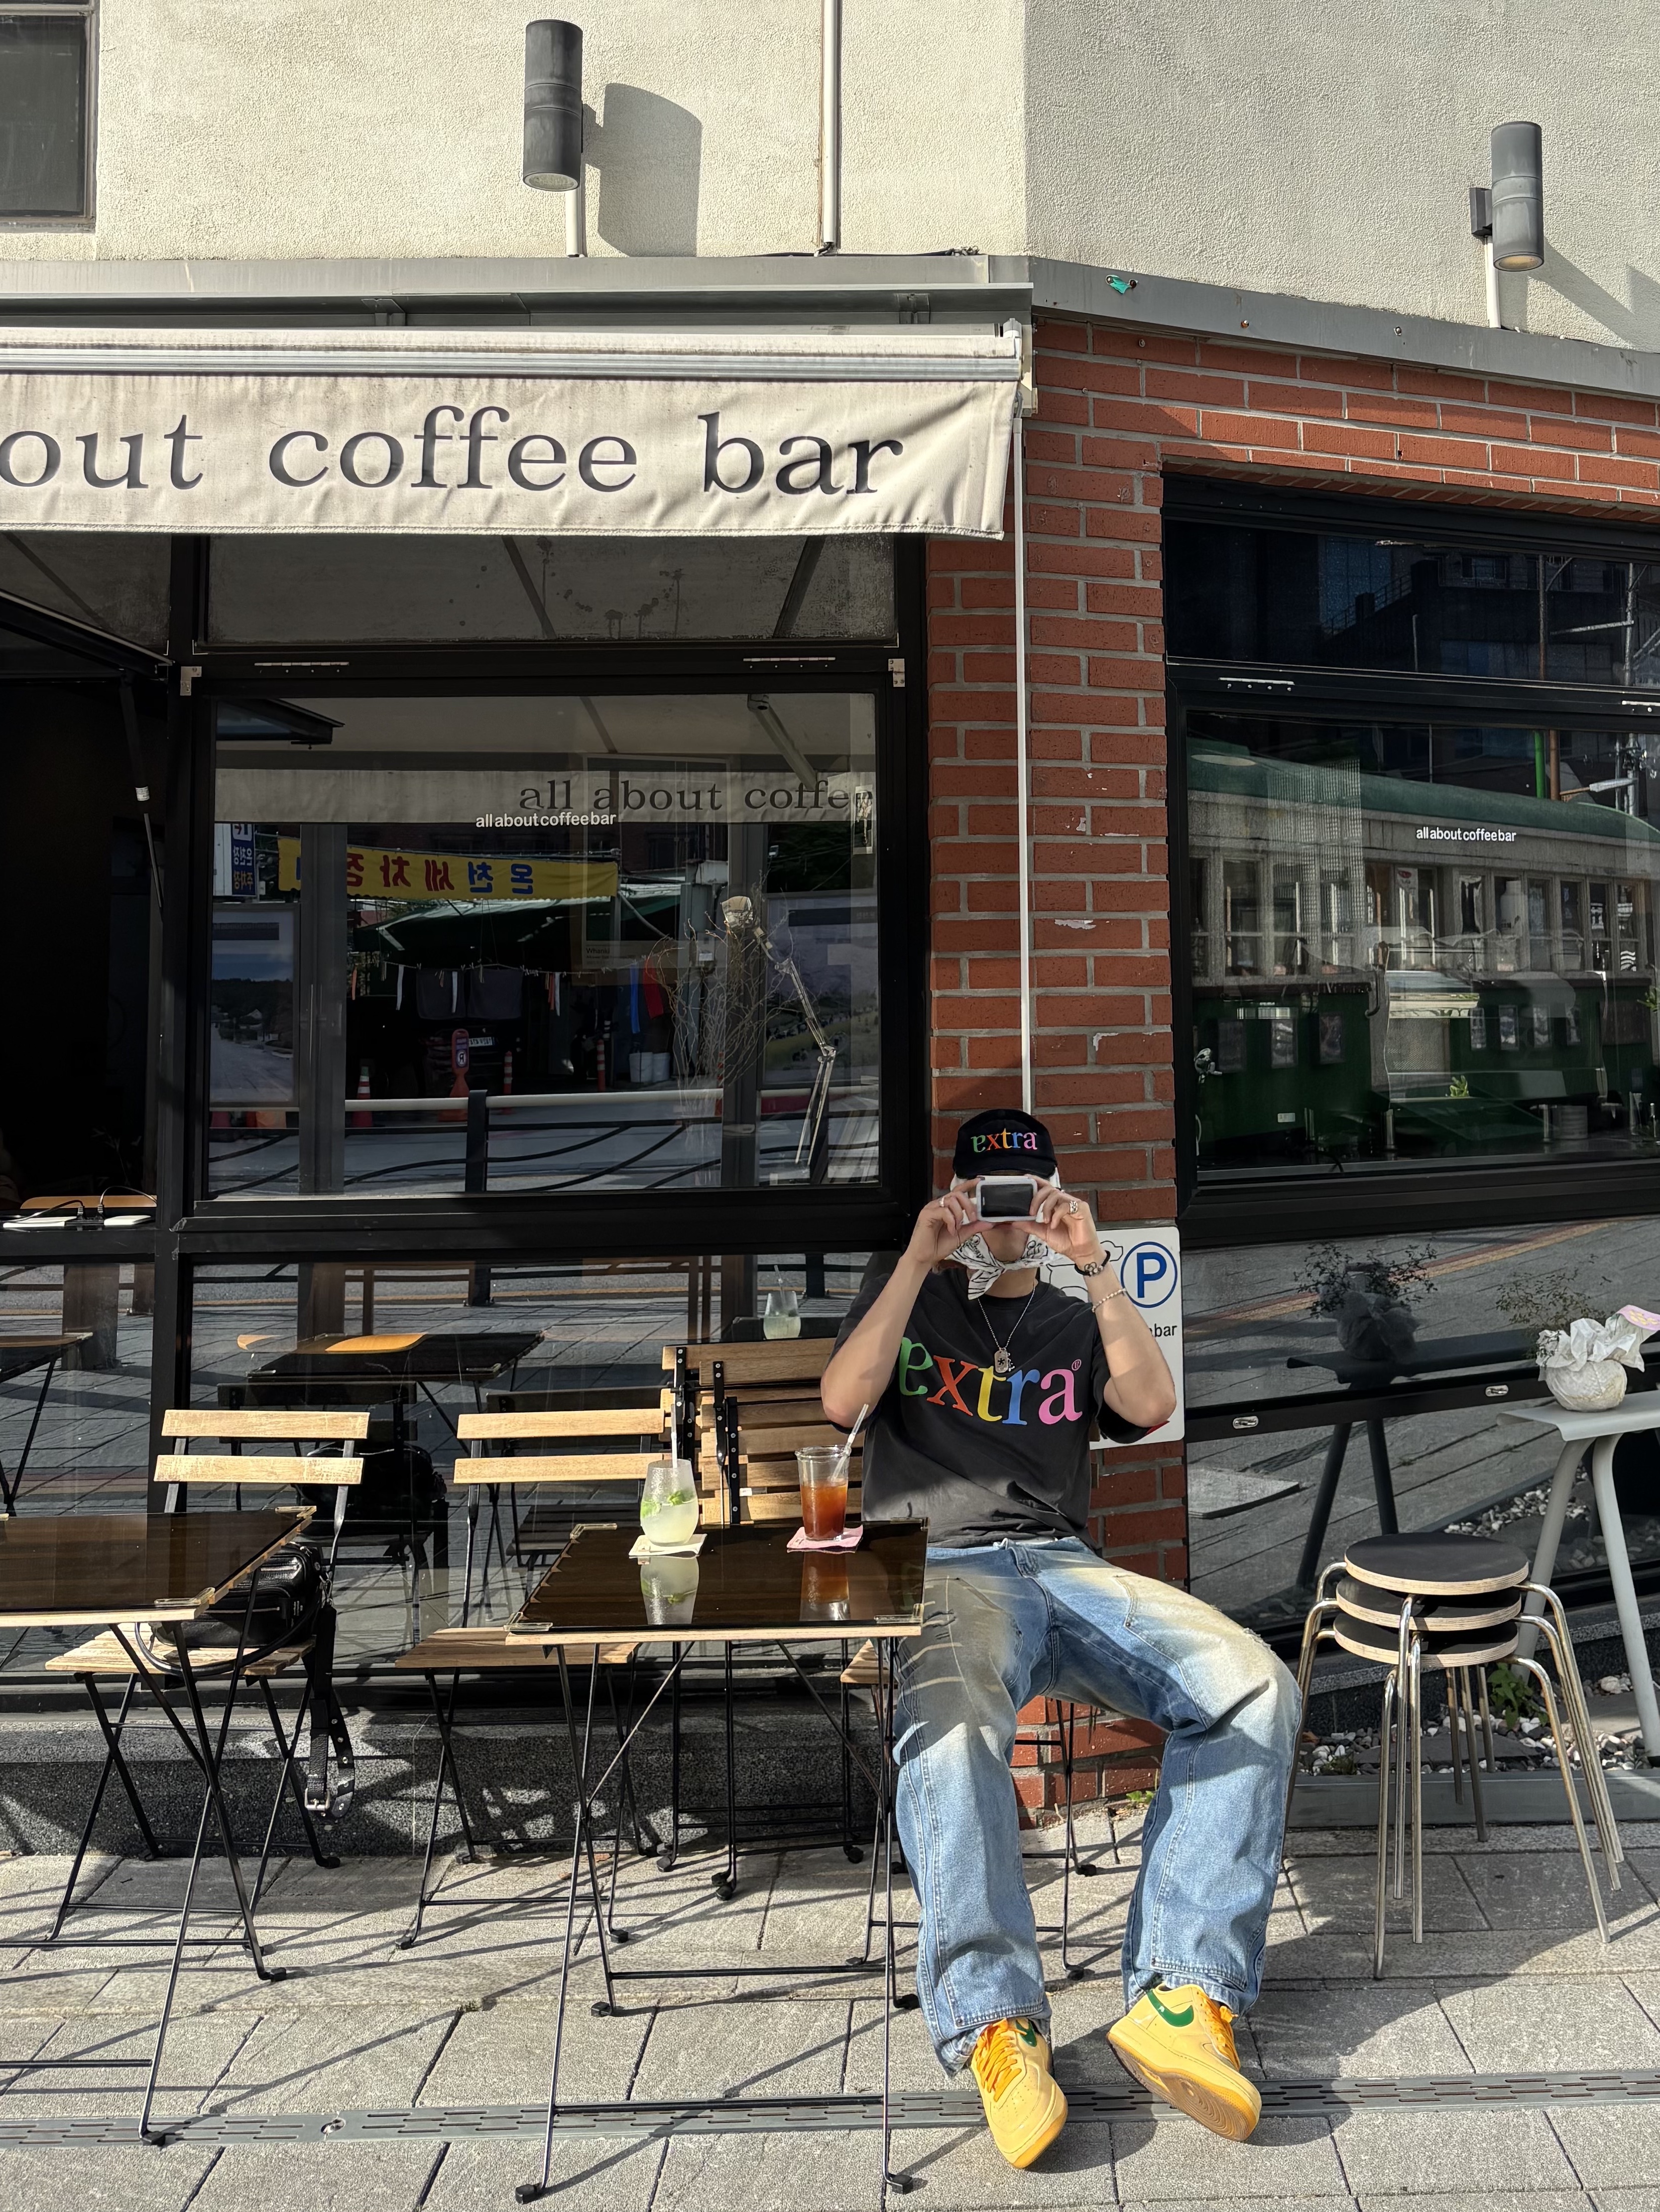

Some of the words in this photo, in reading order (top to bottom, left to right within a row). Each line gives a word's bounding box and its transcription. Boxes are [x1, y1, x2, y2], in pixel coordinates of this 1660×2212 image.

[269, 406, 637, 493] coffee
[697, 411, 903, 495] bar
[520, 780, 572, 810] all
[593, 780, 722, 810] about
[971, 1128, 1038, 1153] extra
[1136, 1252, 1167, 1298] P
[1149, 1323, 1177, 1337] bar
